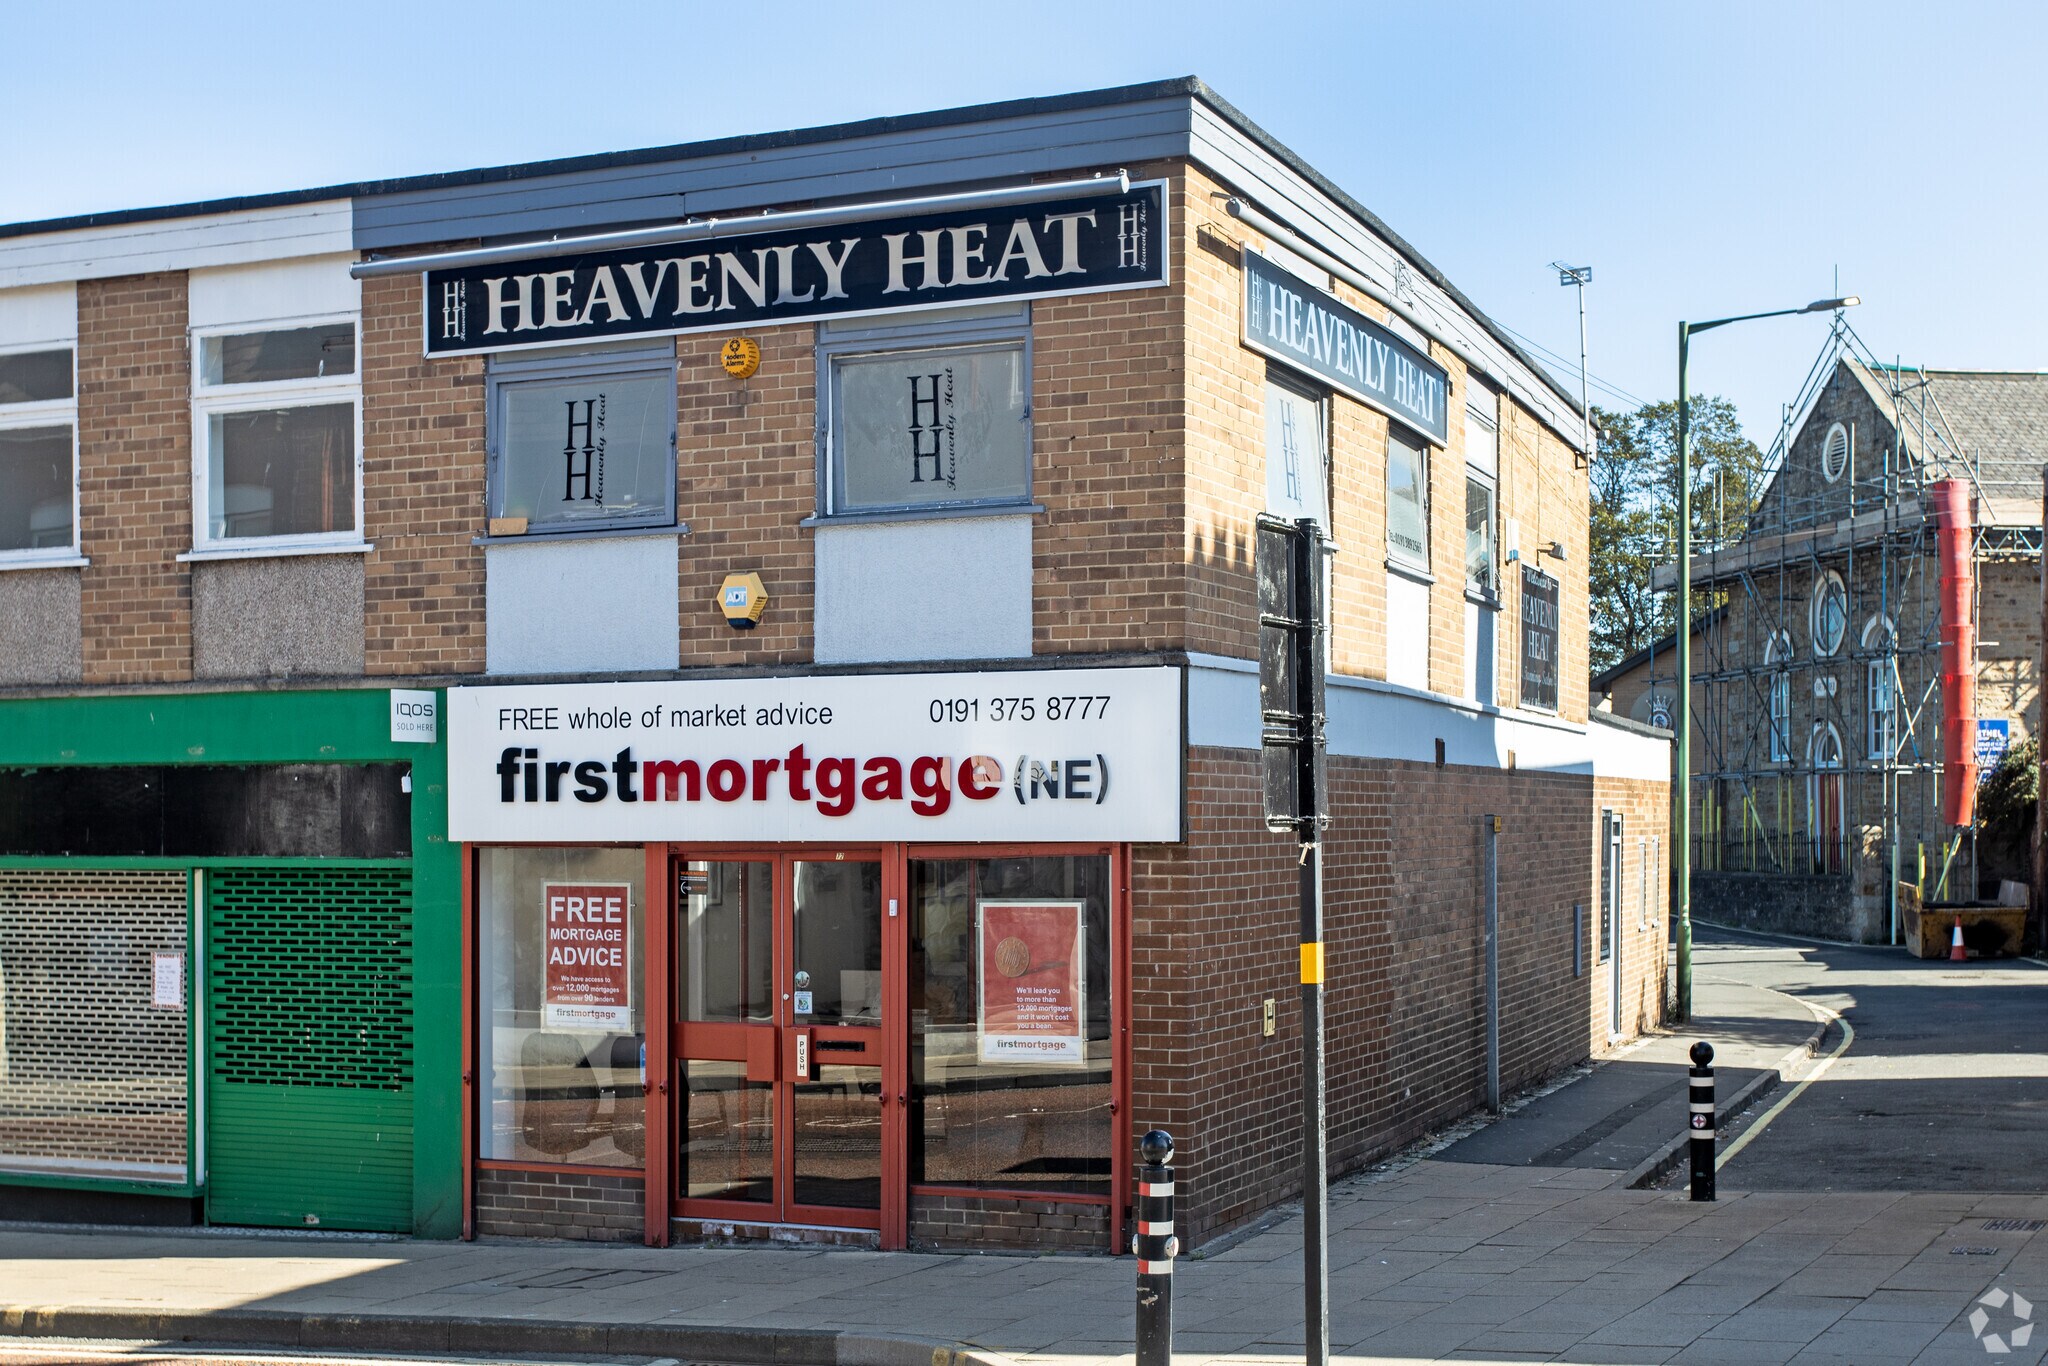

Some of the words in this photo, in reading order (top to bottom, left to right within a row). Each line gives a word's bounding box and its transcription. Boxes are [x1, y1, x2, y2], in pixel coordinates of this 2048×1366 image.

[482, 237, 861, 335] HEAVENLY
[882, 208, 1097, 294] HEAT
[1267, 281, 1389, 395] HEAVENLY
[1393, 351, 1437, 425] HEAT
[944, 366, 954, 408] Heat
[597, 392, 606, 432] Heat
[945, 414, 957, 491] Heavenly
[595, 436, 607, 509] Heavenly
[726, 590, 747, 604] ADT
[1528, 629, 1550, 661] HEAT
[396, 703, 434, 718] IQOS
[499, 708, 559, 731] FREE
[568, 706, 632, 730] whole
[641, 705, 663, 728] of
[671, 703, 747, 728] market
[755, 702, 833, 726] advice
[929, 698, 979, 723] 0191
[990, 697, 1036, 722] 375
[1046, 696, 1111, 721] 8777
[396, 722, 415, 731] SOLD
[417, 723, 433, 732] HERE
[496, 743, 1004, 817] firstmortgage
[1013, 754, 1110, 805] (NE)
[550, 896, 622, 923] FREE
[550, 928, 622, 942] MORTGAGE
[549, 946, 622, 967] ADVICE
[565, 983, 590, 993] 12,000
[590, 986, 619, 994] mortgages
[584, 994, 593, 1002] 90
[1048, 988, 1060, 996] you
[556, 1008, 616, 1020] firstmortgage
[1038, 1005, 1073, 1013] mortgages
[997, 1039, 1067, 1050] firstmortgage
